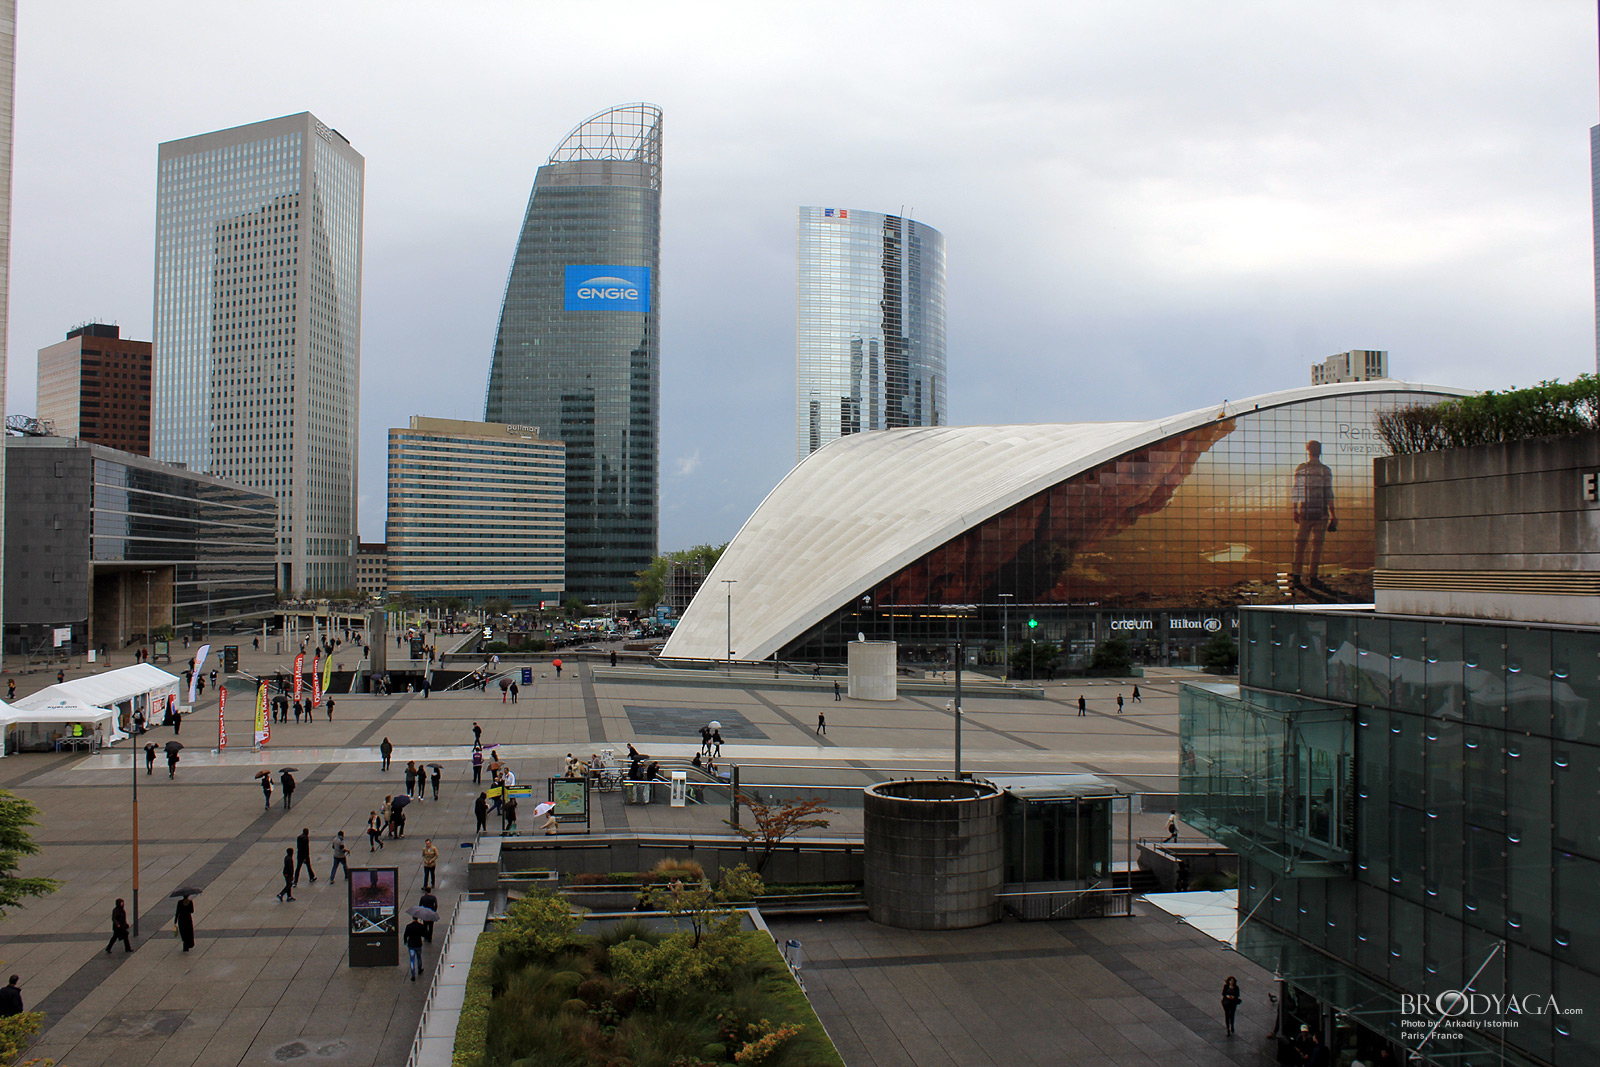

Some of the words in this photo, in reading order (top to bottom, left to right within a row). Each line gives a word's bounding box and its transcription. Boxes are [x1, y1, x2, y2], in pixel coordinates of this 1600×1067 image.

[1339, 424, 1382, 440] Rena
[1340, 442, 1365, 453] Vivez
[1583, 473, 1600, 500] E
[1111, 619, 1153, 630] arteum
[1170, 619, 1202, 629] Hilton
